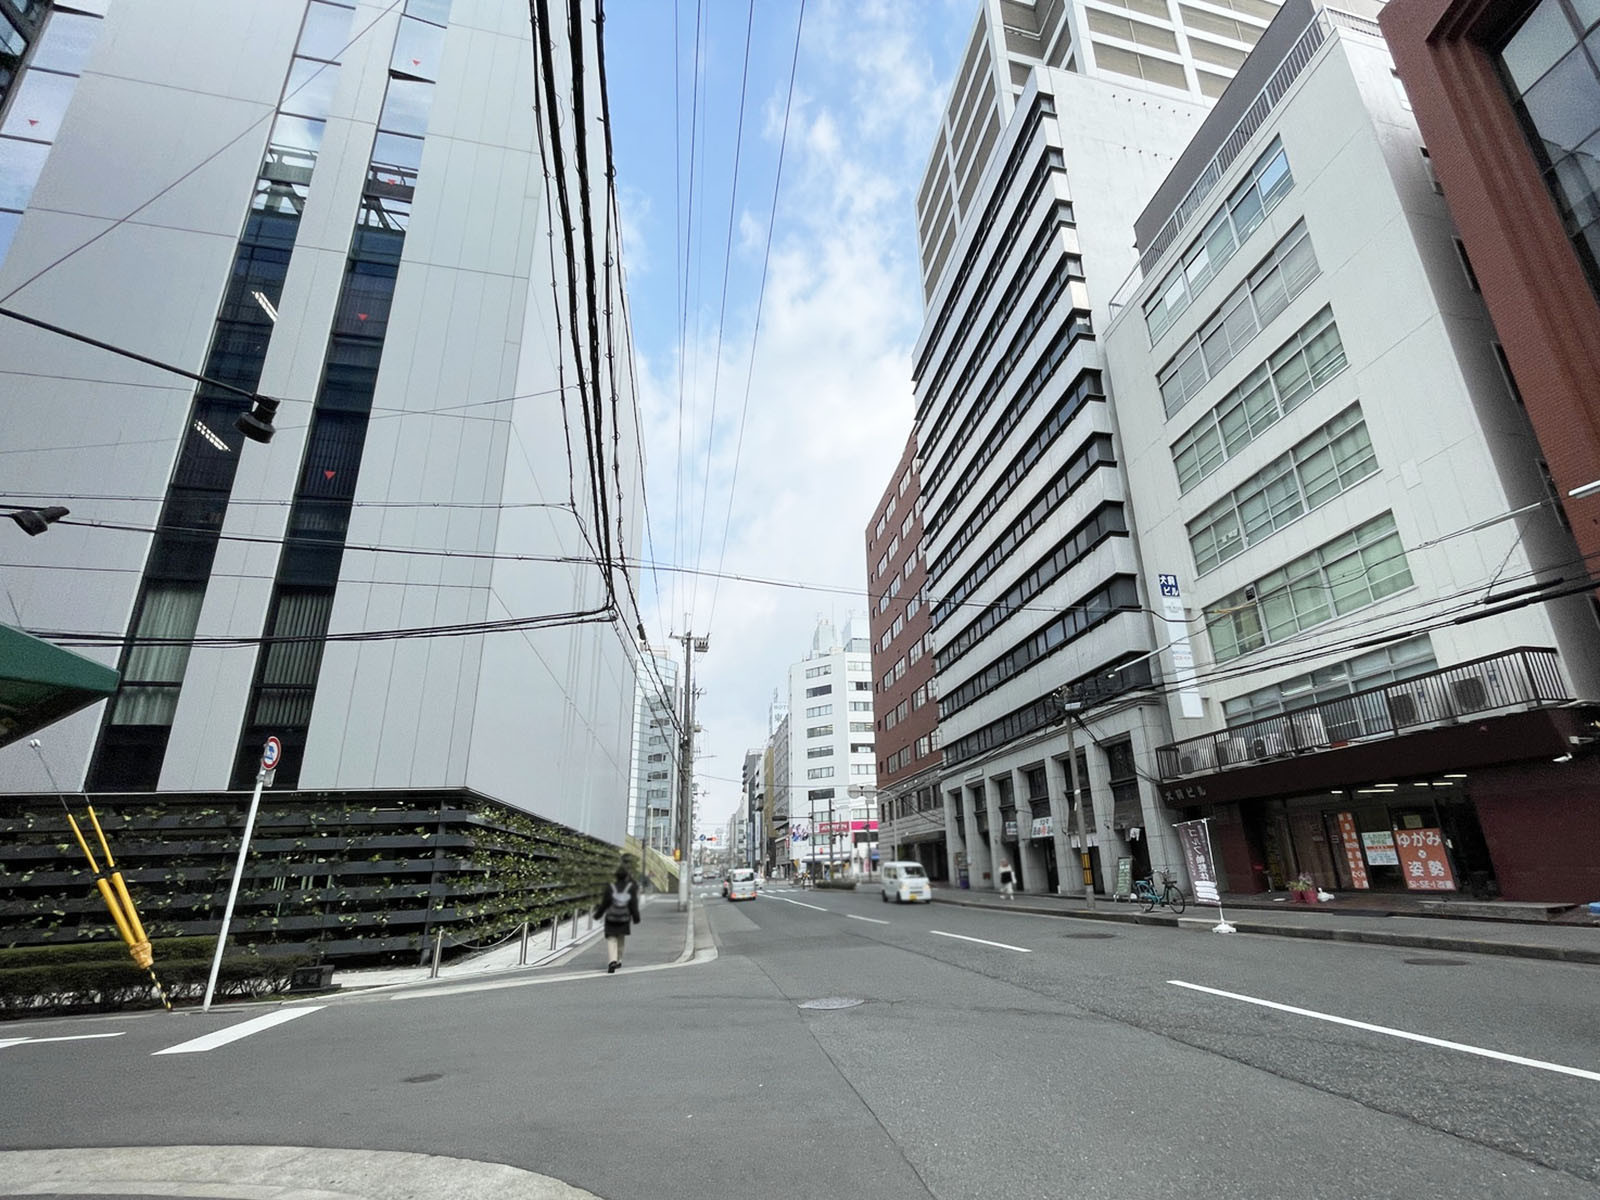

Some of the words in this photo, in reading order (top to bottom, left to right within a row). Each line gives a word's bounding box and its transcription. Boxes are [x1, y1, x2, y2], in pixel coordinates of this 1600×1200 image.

[1163, 587, 1178, 595] ビル
[1396, 831, 1441, 848] ゆがみ
[1407, 860, 1445, 877] 姿勢
